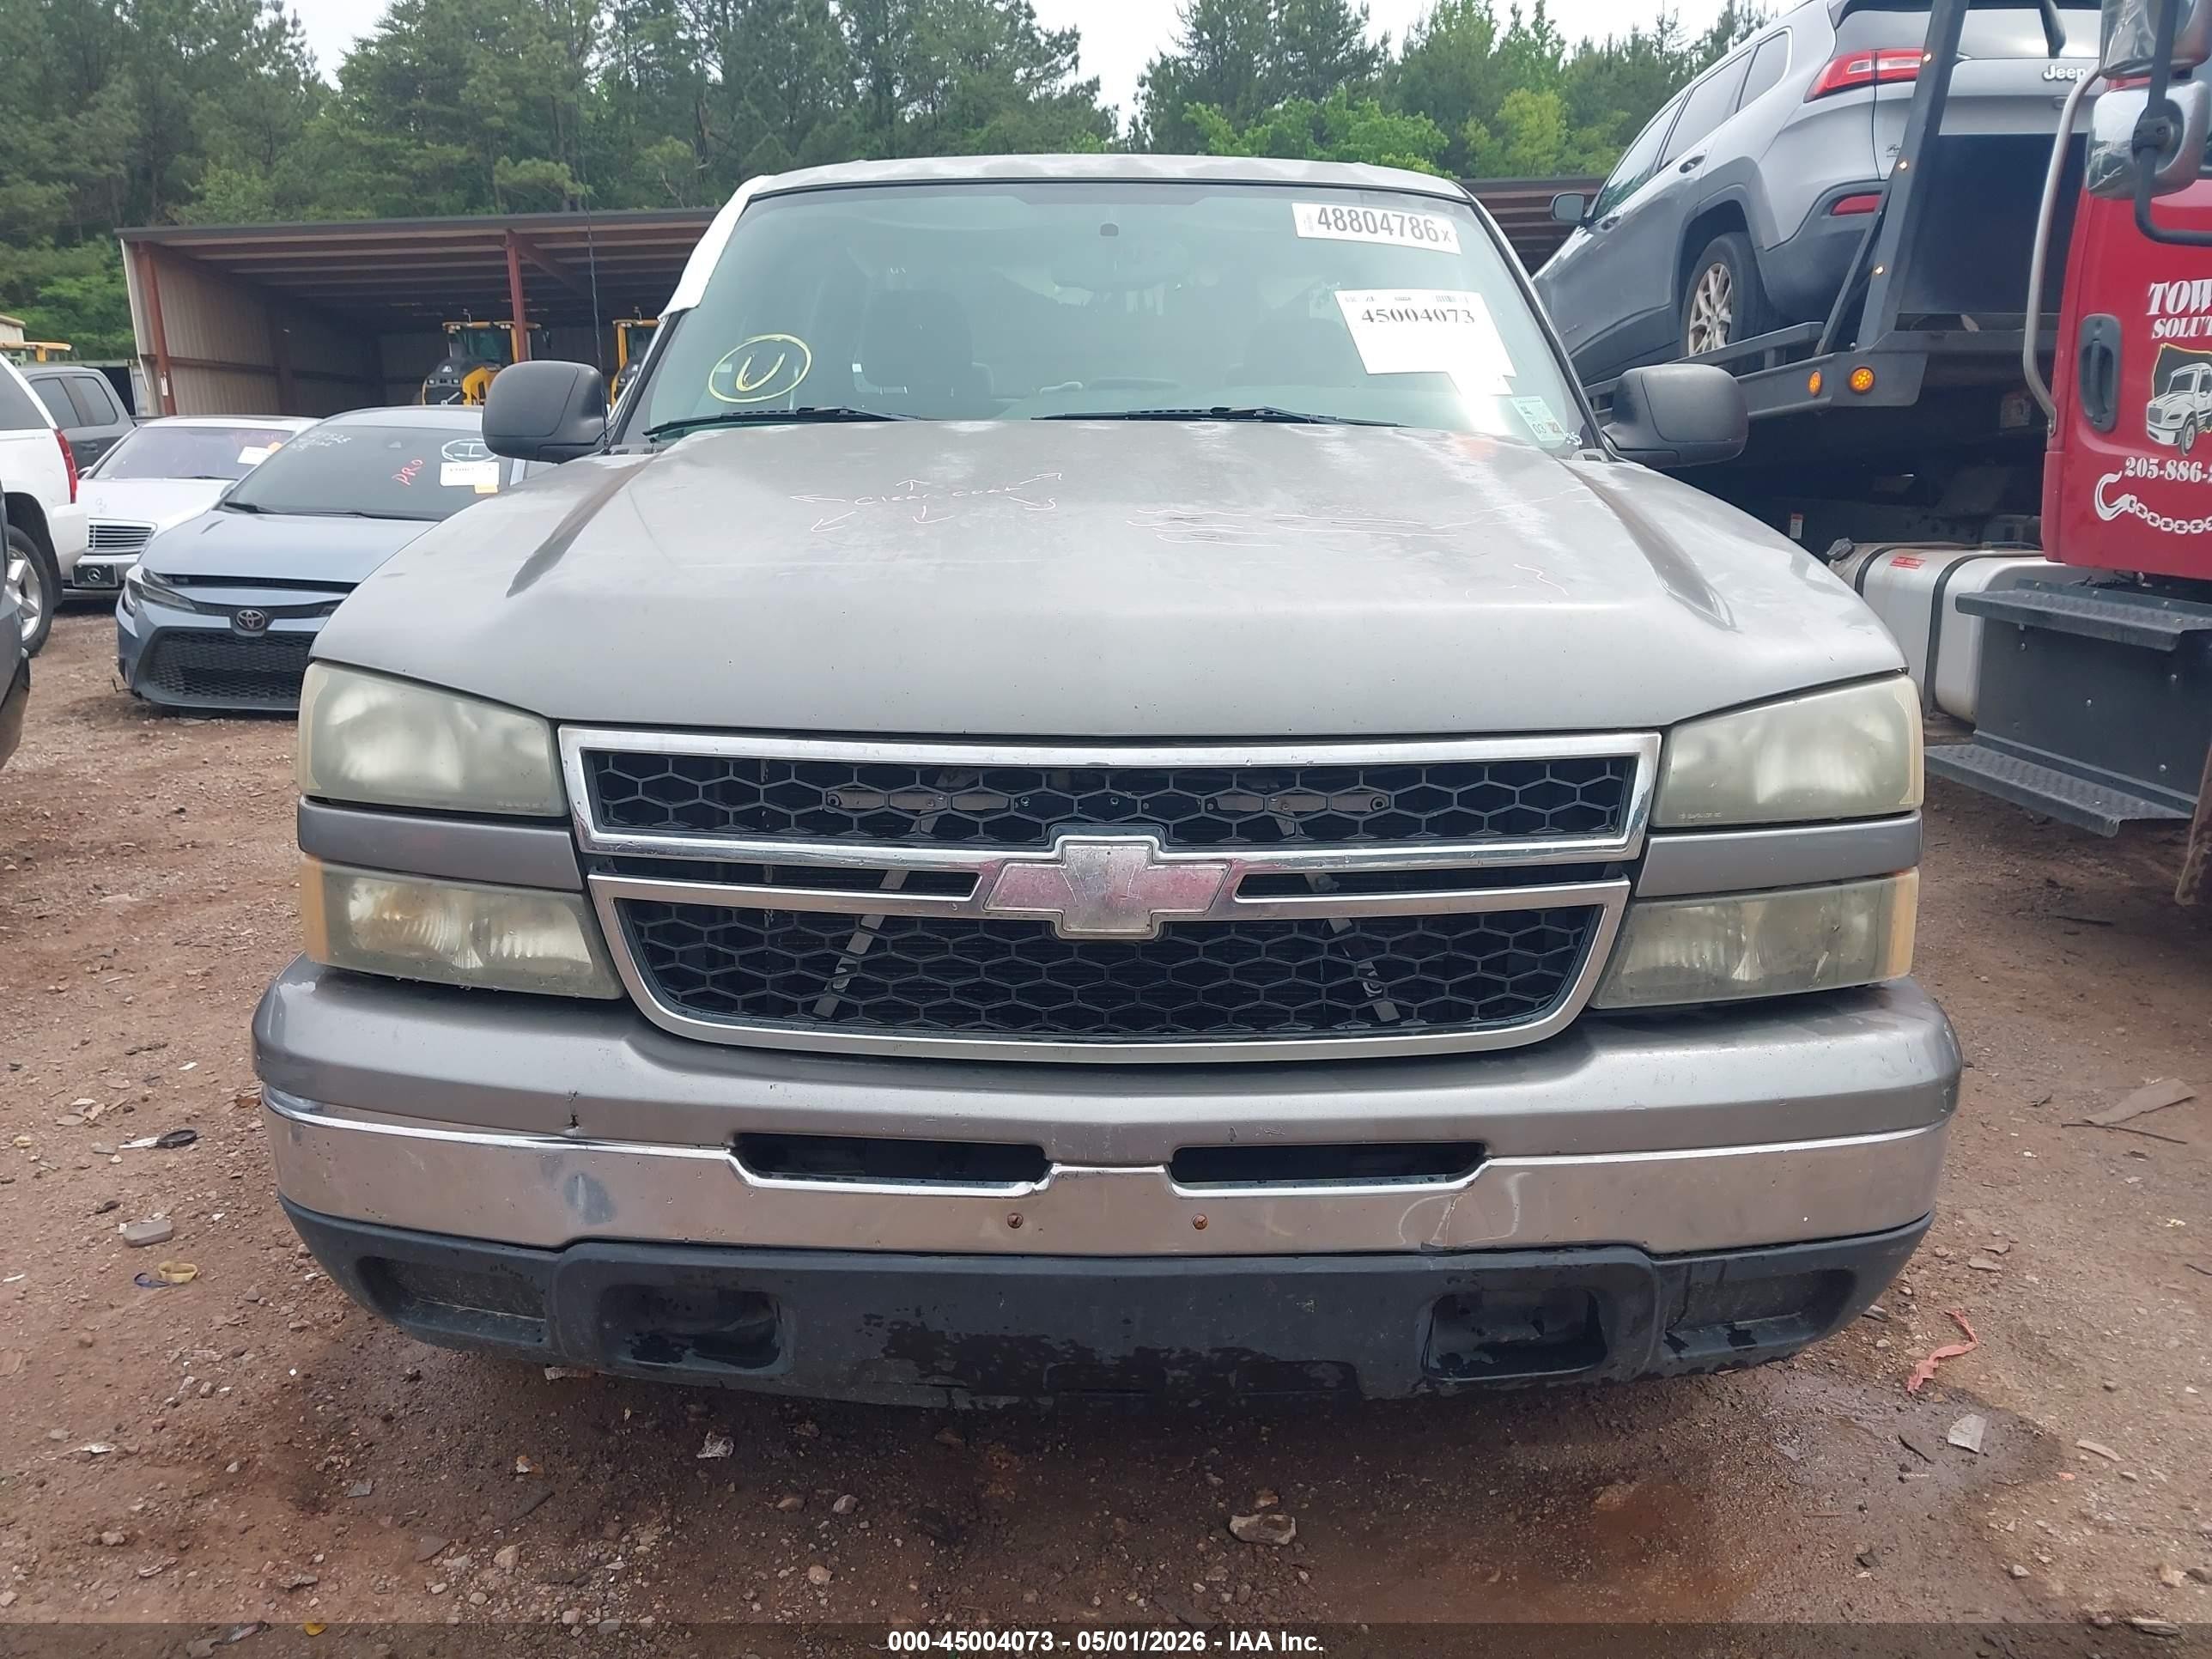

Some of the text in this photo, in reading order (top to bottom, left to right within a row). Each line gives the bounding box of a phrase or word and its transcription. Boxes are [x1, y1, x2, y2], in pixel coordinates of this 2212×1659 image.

[2043, 64, 2087, 83] Jeep
[1317, 207, 1439, 242] 48804786
[1362, 308, 1475, 324] 45004073
